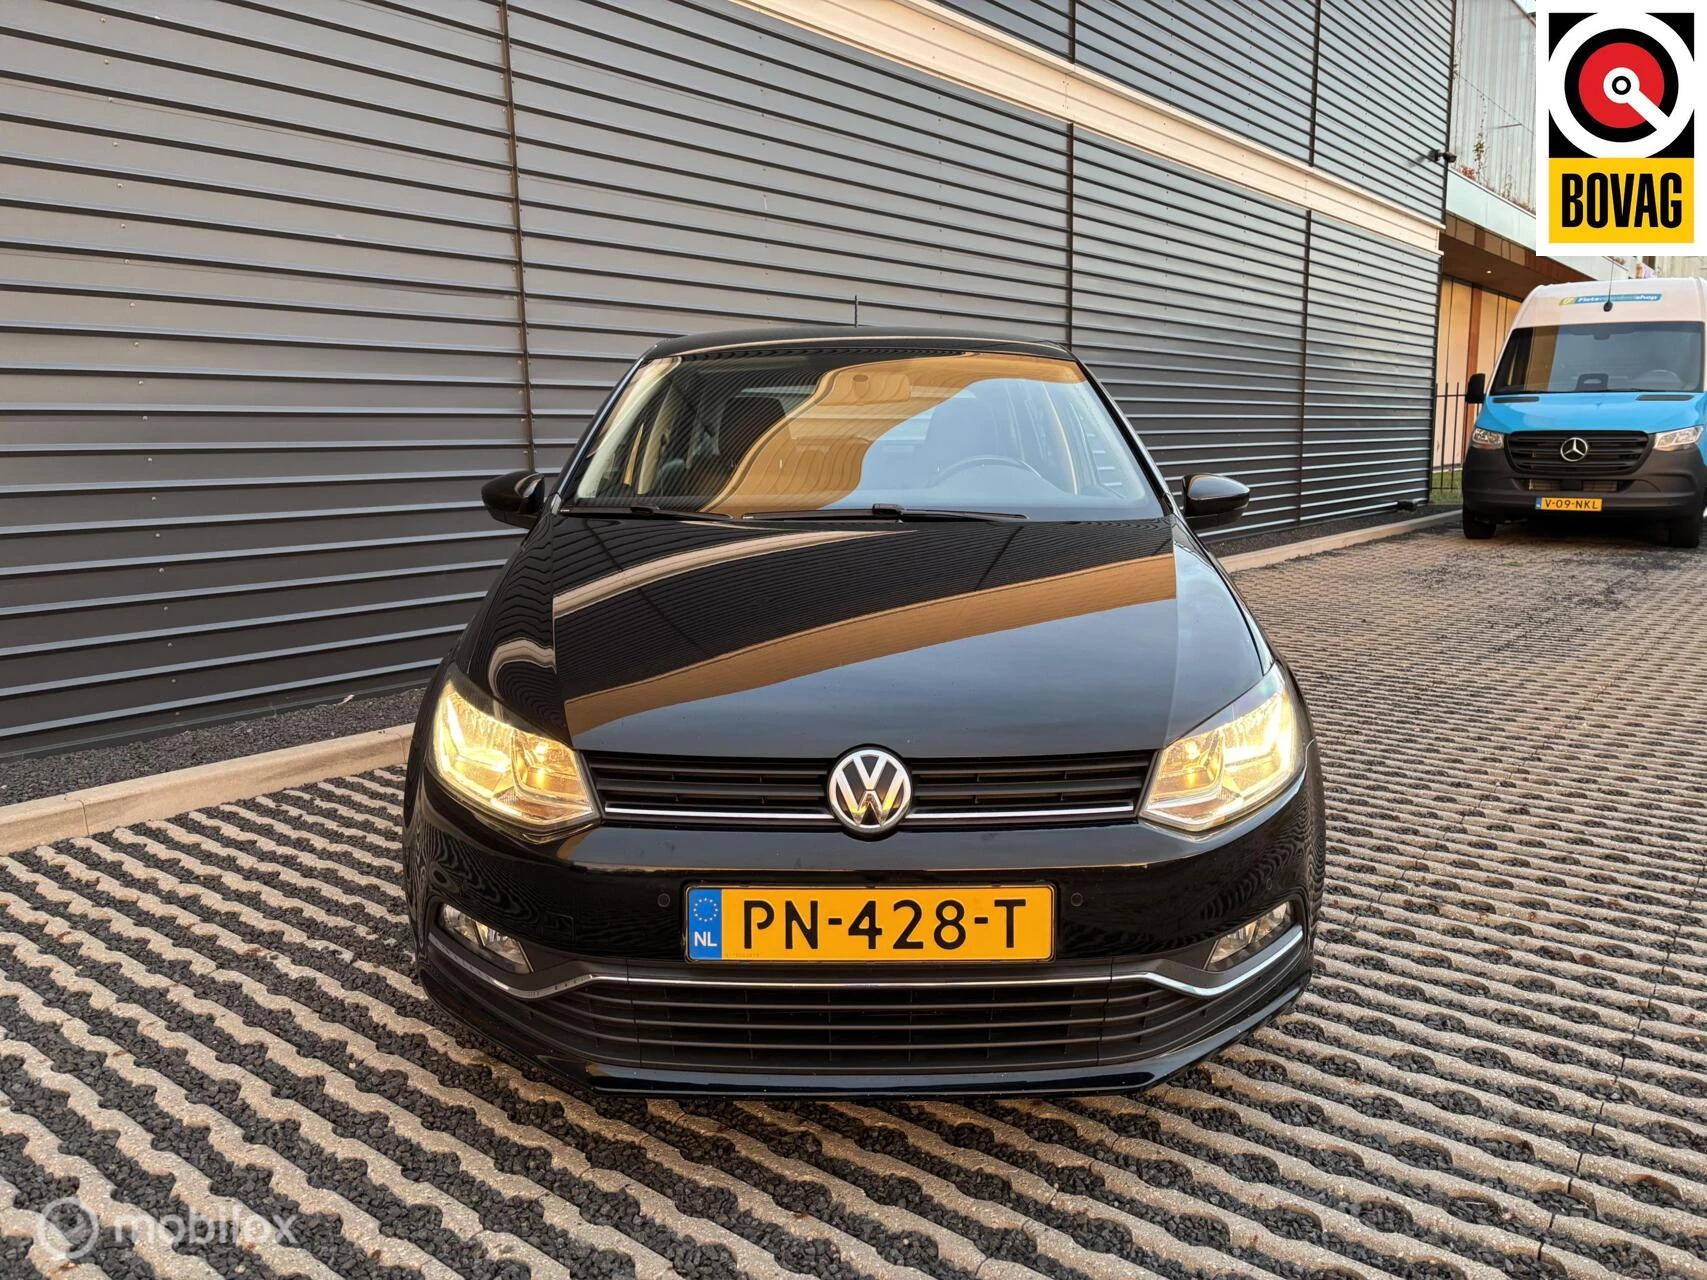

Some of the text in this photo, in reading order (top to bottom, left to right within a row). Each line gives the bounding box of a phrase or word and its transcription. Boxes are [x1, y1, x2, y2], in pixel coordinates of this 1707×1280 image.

[1545, 499, 1599, 510] V-09-NKL
[694, 898, 1026, 950] NL PN-428-T
